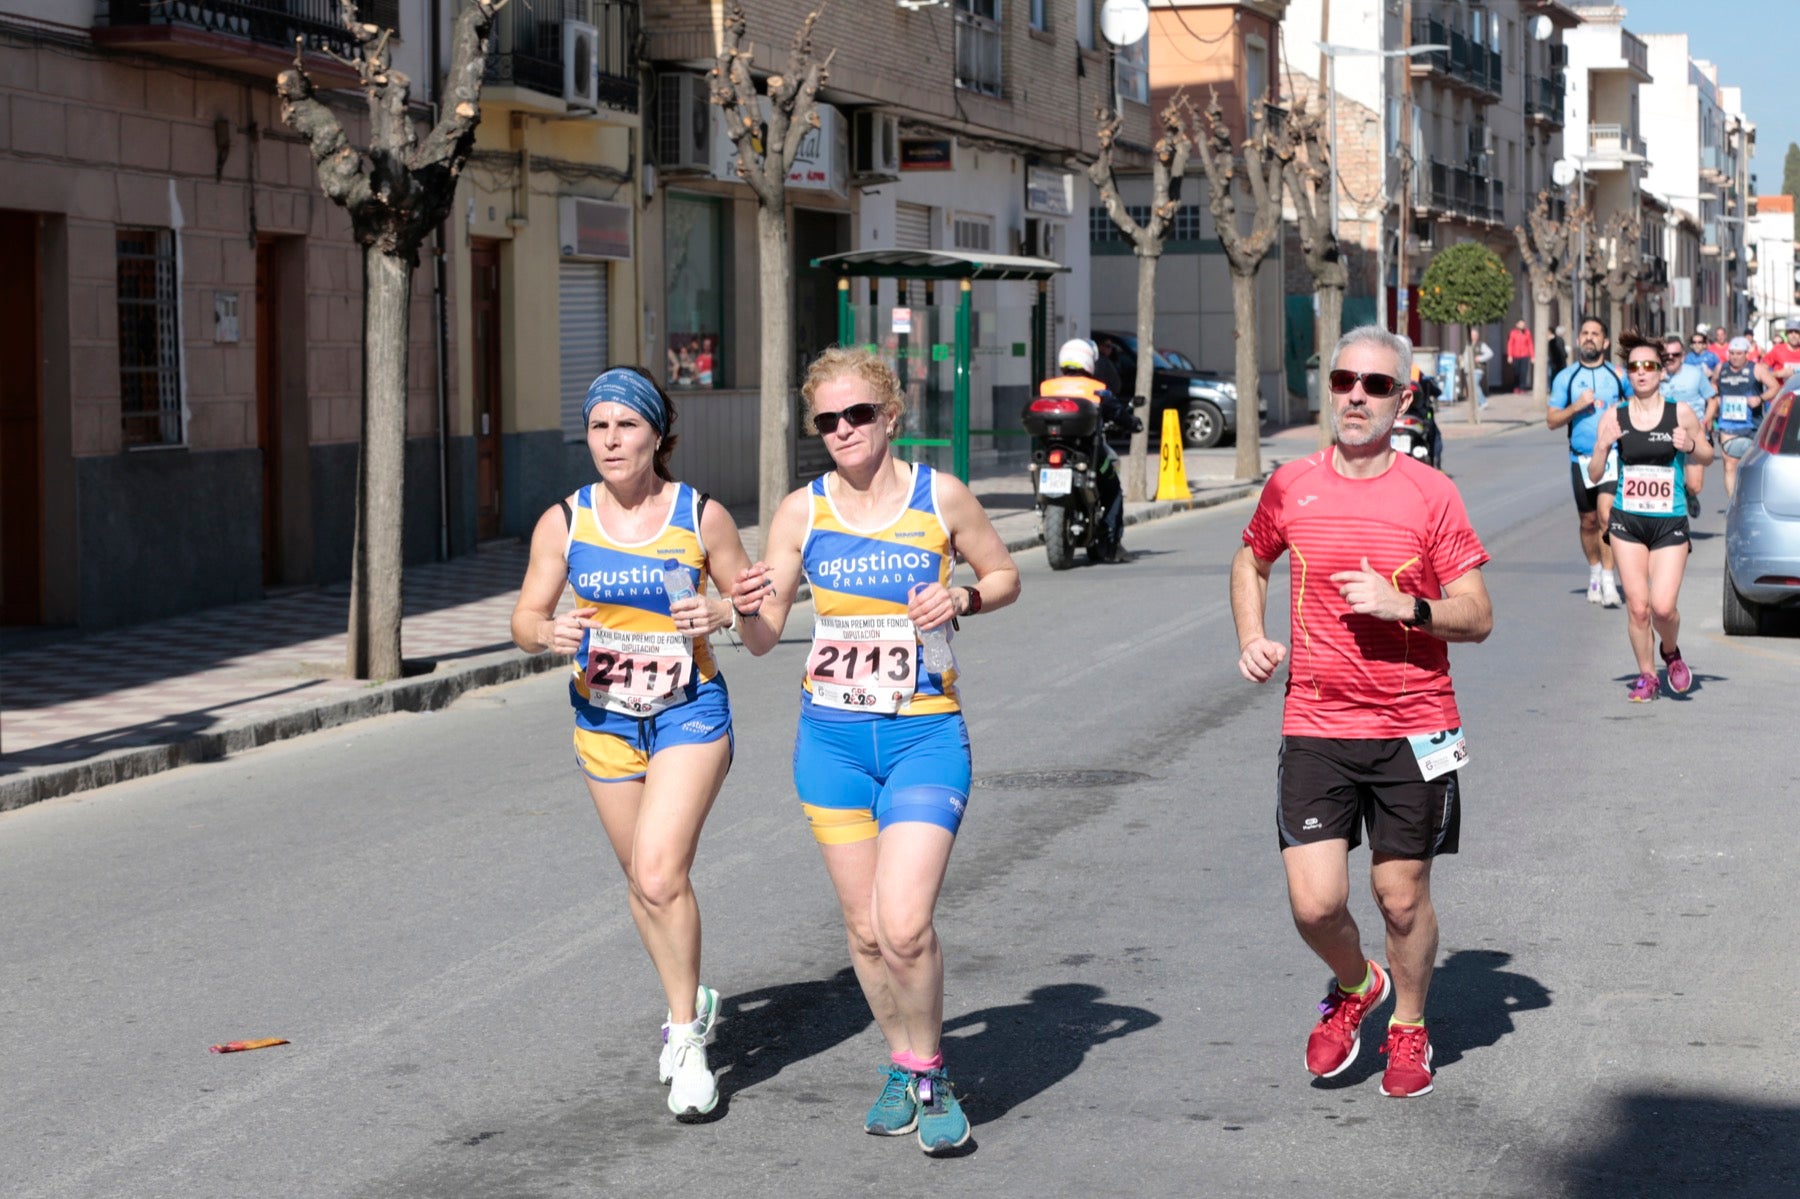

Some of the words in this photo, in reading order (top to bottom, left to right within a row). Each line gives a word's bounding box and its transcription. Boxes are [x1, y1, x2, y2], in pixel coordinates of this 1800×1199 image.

[1626, 480, 1671, 498] 2006
[818, 550, 931, 581] agustinos
[579, 564, 691, 593] agustin
[833, 573, 915, 588] GRANADA
[593, 582, 664, 598] GRANAD
[851, 619, 875, 629] PREMIO
[877, 618, 885, 628] DE
[887, 618, 909, 628] FONDO
[614, 632, 631, 642] GRAN
[632, 634, 656, 644] PREMIO
[657, 635, 665, 644] DE
[666, 635, 687, 645] FONDO
[590, 652, 682, 693] 2111
[814, 645, 911, 682] 2113
